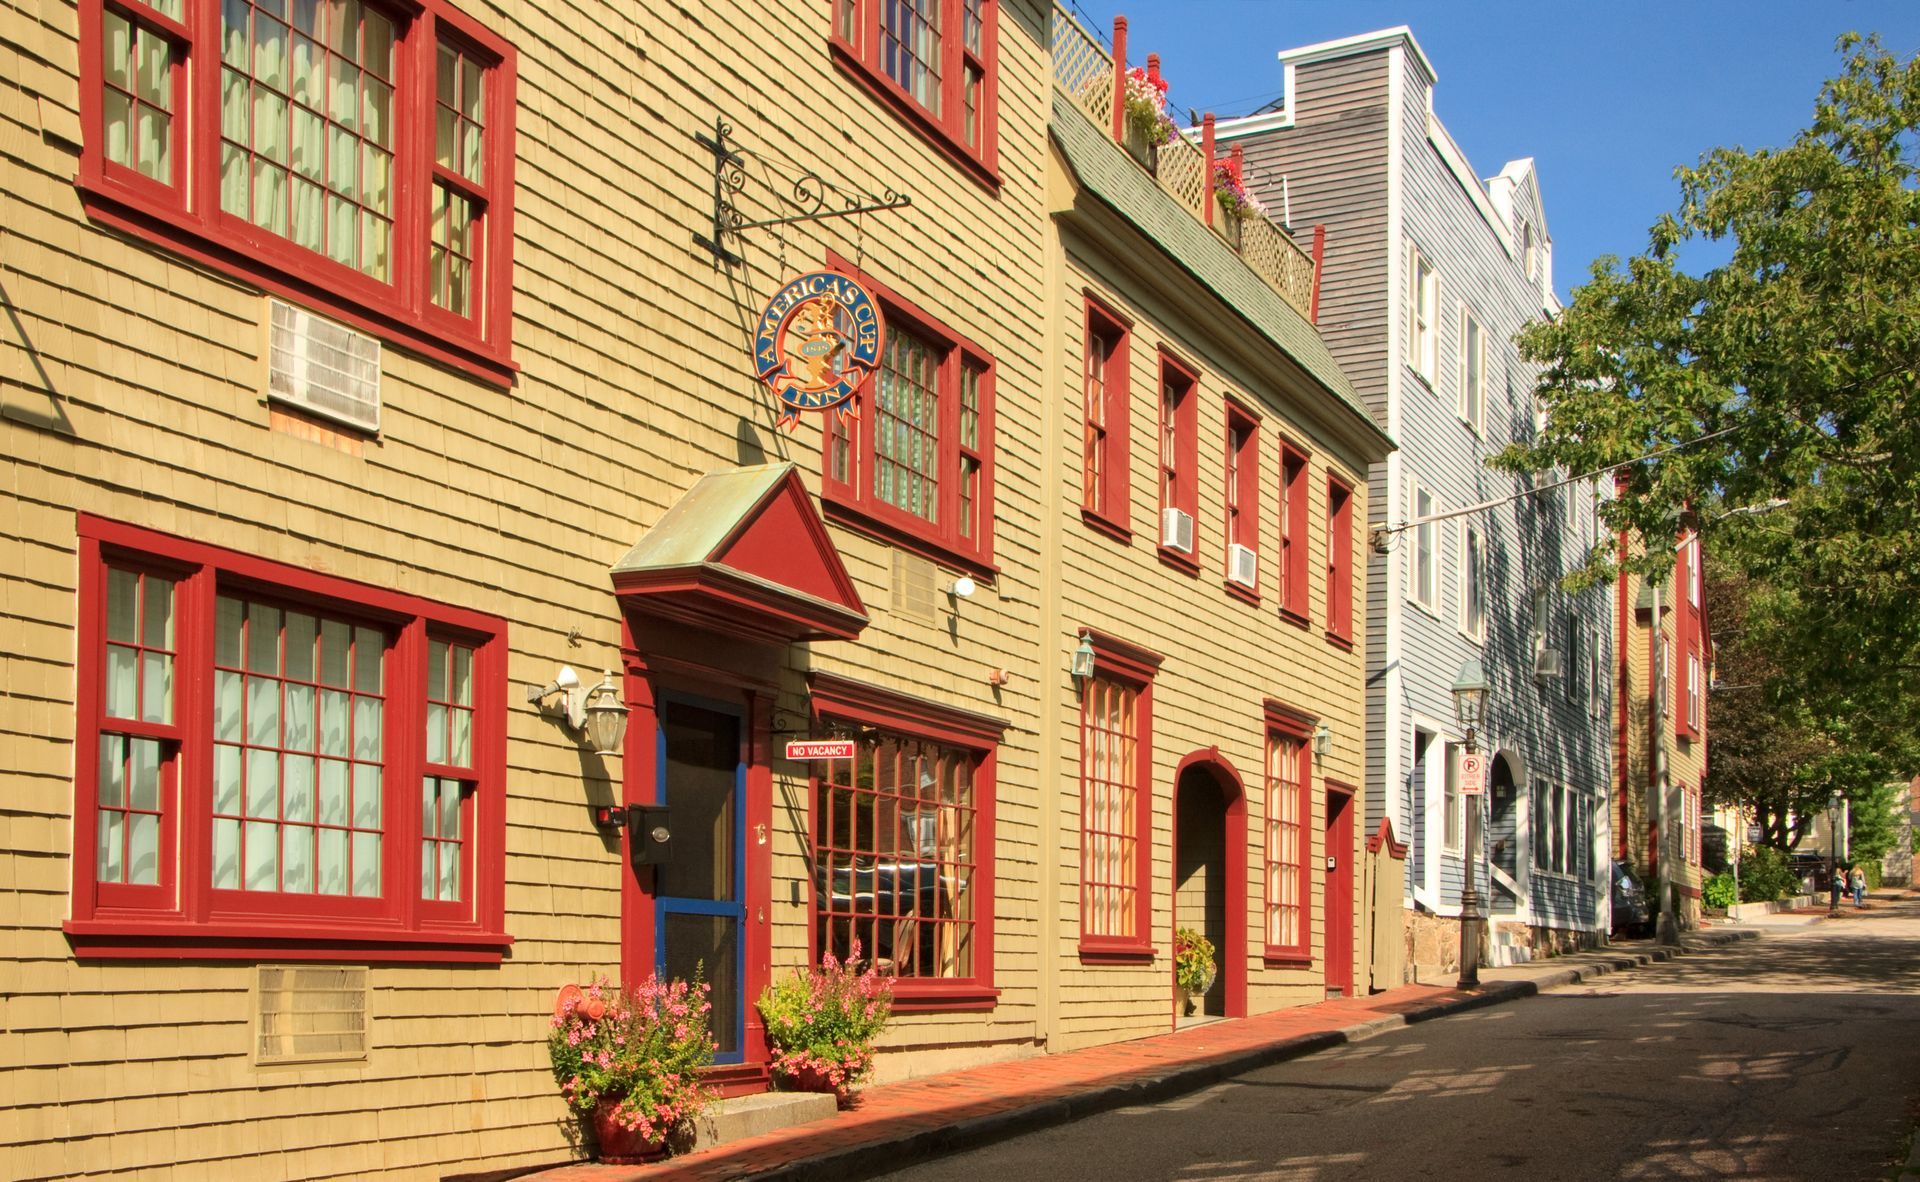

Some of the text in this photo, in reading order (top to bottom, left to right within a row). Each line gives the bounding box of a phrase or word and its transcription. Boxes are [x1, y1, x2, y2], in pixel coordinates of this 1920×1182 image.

[759, 276, 877, 363] AMERICA'S CUP
[793, 387, 842, 407] INN
[792, 745, 848, 756] NO VACANCY
